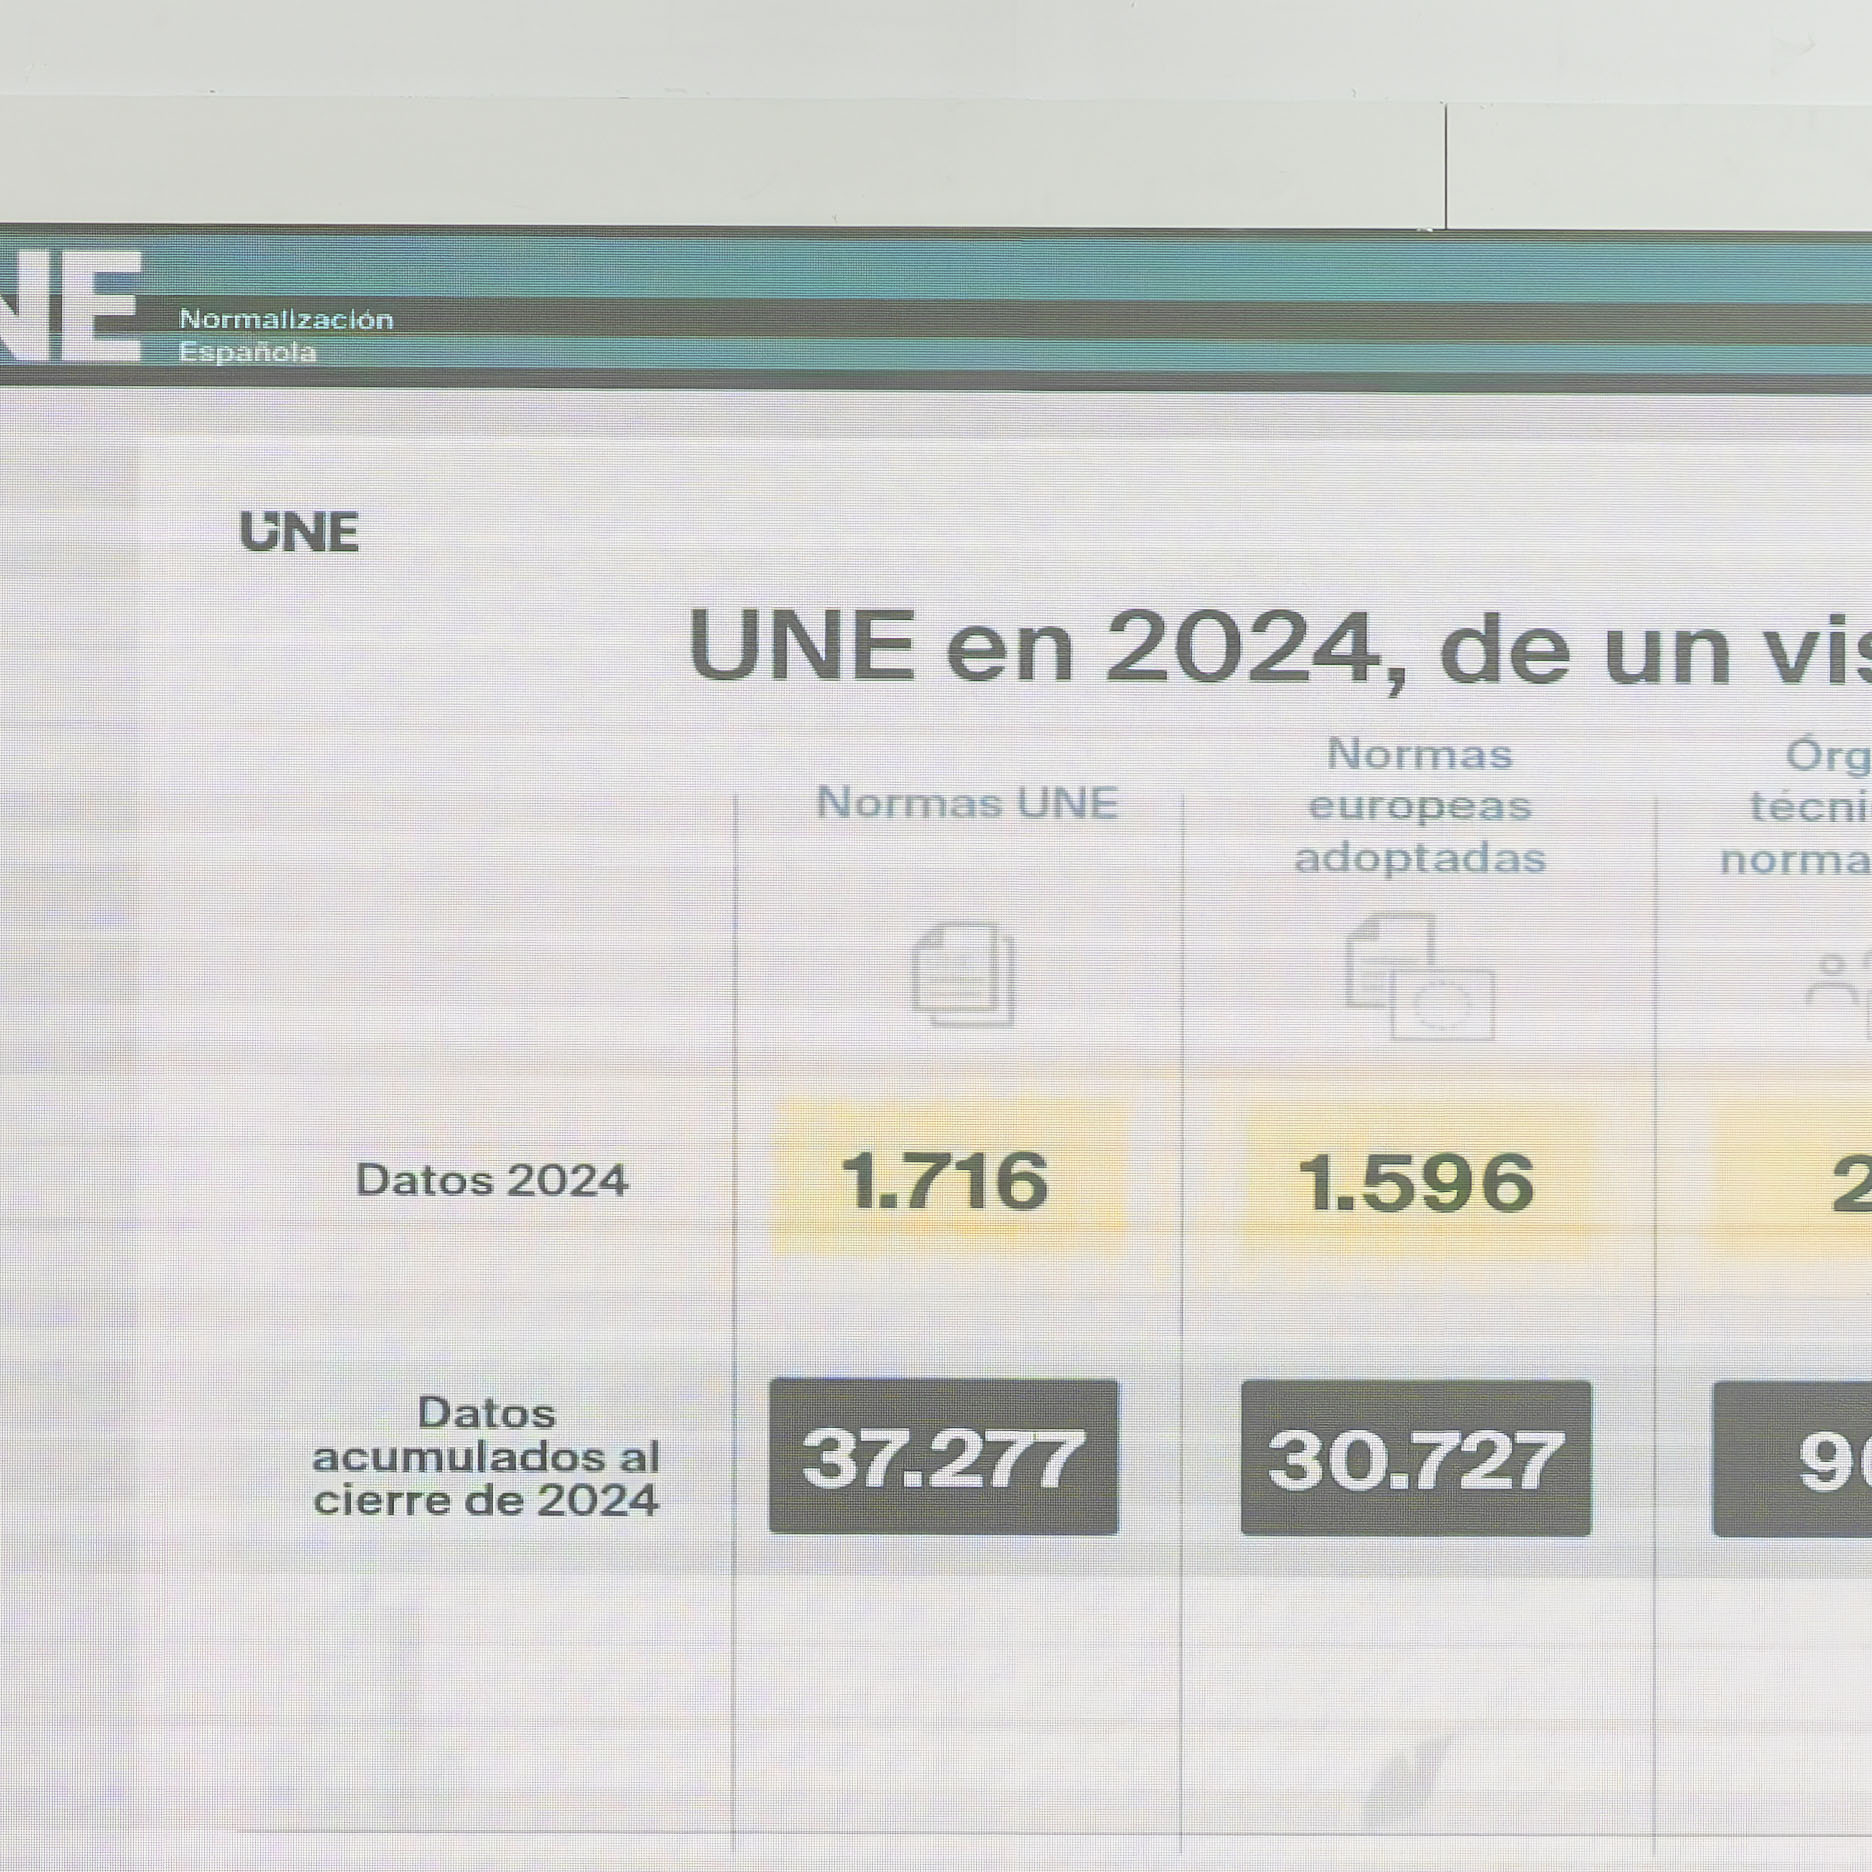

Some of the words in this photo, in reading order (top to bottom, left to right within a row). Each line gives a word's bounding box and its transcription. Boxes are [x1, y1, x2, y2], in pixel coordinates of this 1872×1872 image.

[181, 309, 393, 329] Normalización
[180, 341, 316, 364] Española
[241, 512, 358, 552] UNE
[692, 609, 913, 681] UNE
[948, 626, 1072, 682] en
[1108, 609, 1405, 698] 2024,
[1441, 612, 1570, 684] de
[1607, 630, 1729, 685] un
[1329, 736, 1512, 769] Normas
[818, 785, 1003, 819] Normas
[1018, 787, 1116, 819] UNE
[1309, 797, 1531, 829] europeas
[1295, 841, 1545, 879] adoptadas
[358, 1162, 493, 1196] Datos
[509, 1164, 628, 1196] 2024
[844, 1151, 1047, 1210] 1.716
[1301, 1153, 1533, 1212] 1.596
[419, 1395, 555, 1429] Datos
[314, 1440, 605, 1472] acumulados
[621, 1441, 658, 1472] al
[805, 1428, 1085, 1488] 37.277
[1271, 1430, 1565, 1490] 30.727
[315, 1483, 450, 1515] cierre
[466, 1484, 523, 1515] de
[539, 1483, 658, 1516] 2024
